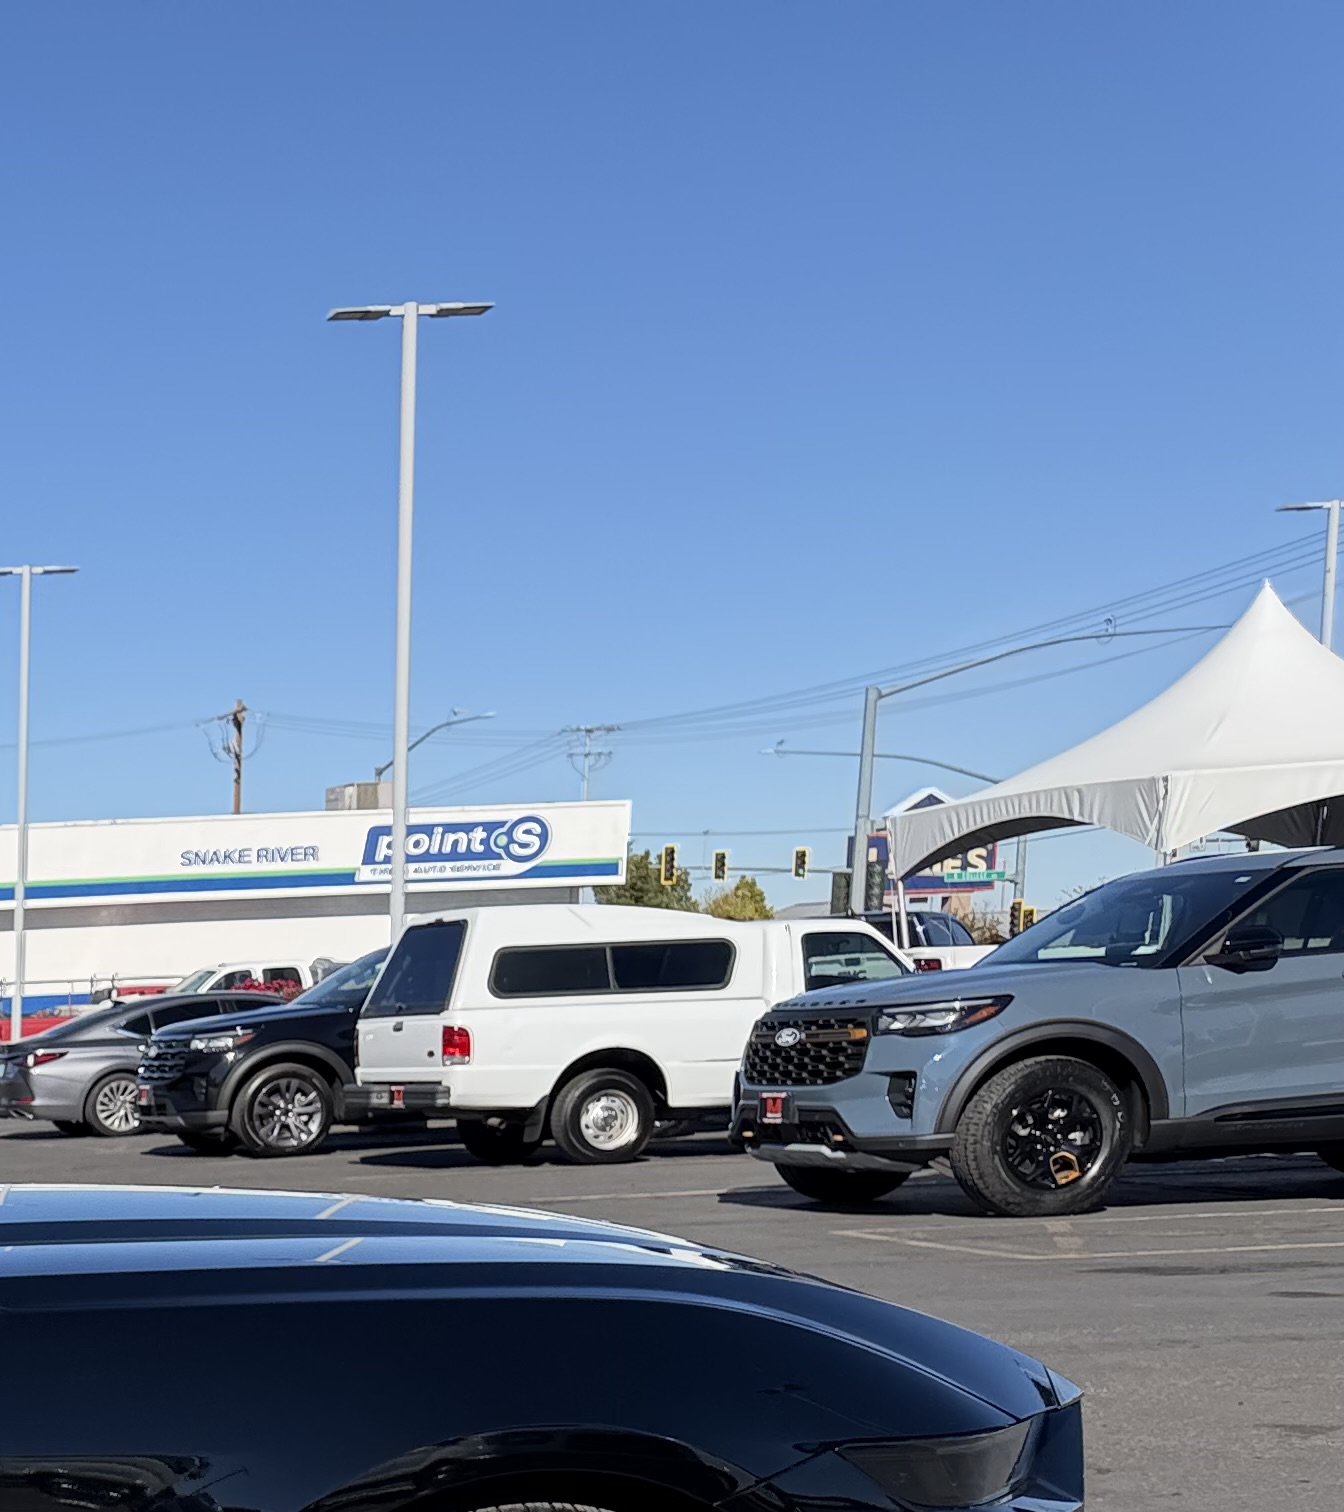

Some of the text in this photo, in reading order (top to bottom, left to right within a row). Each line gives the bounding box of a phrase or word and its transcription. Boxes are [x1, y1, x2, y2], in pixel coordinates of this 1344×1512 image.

[180, 846, 319, 867] SNAKE RIVER
[375, 822, 542, 862] point S
